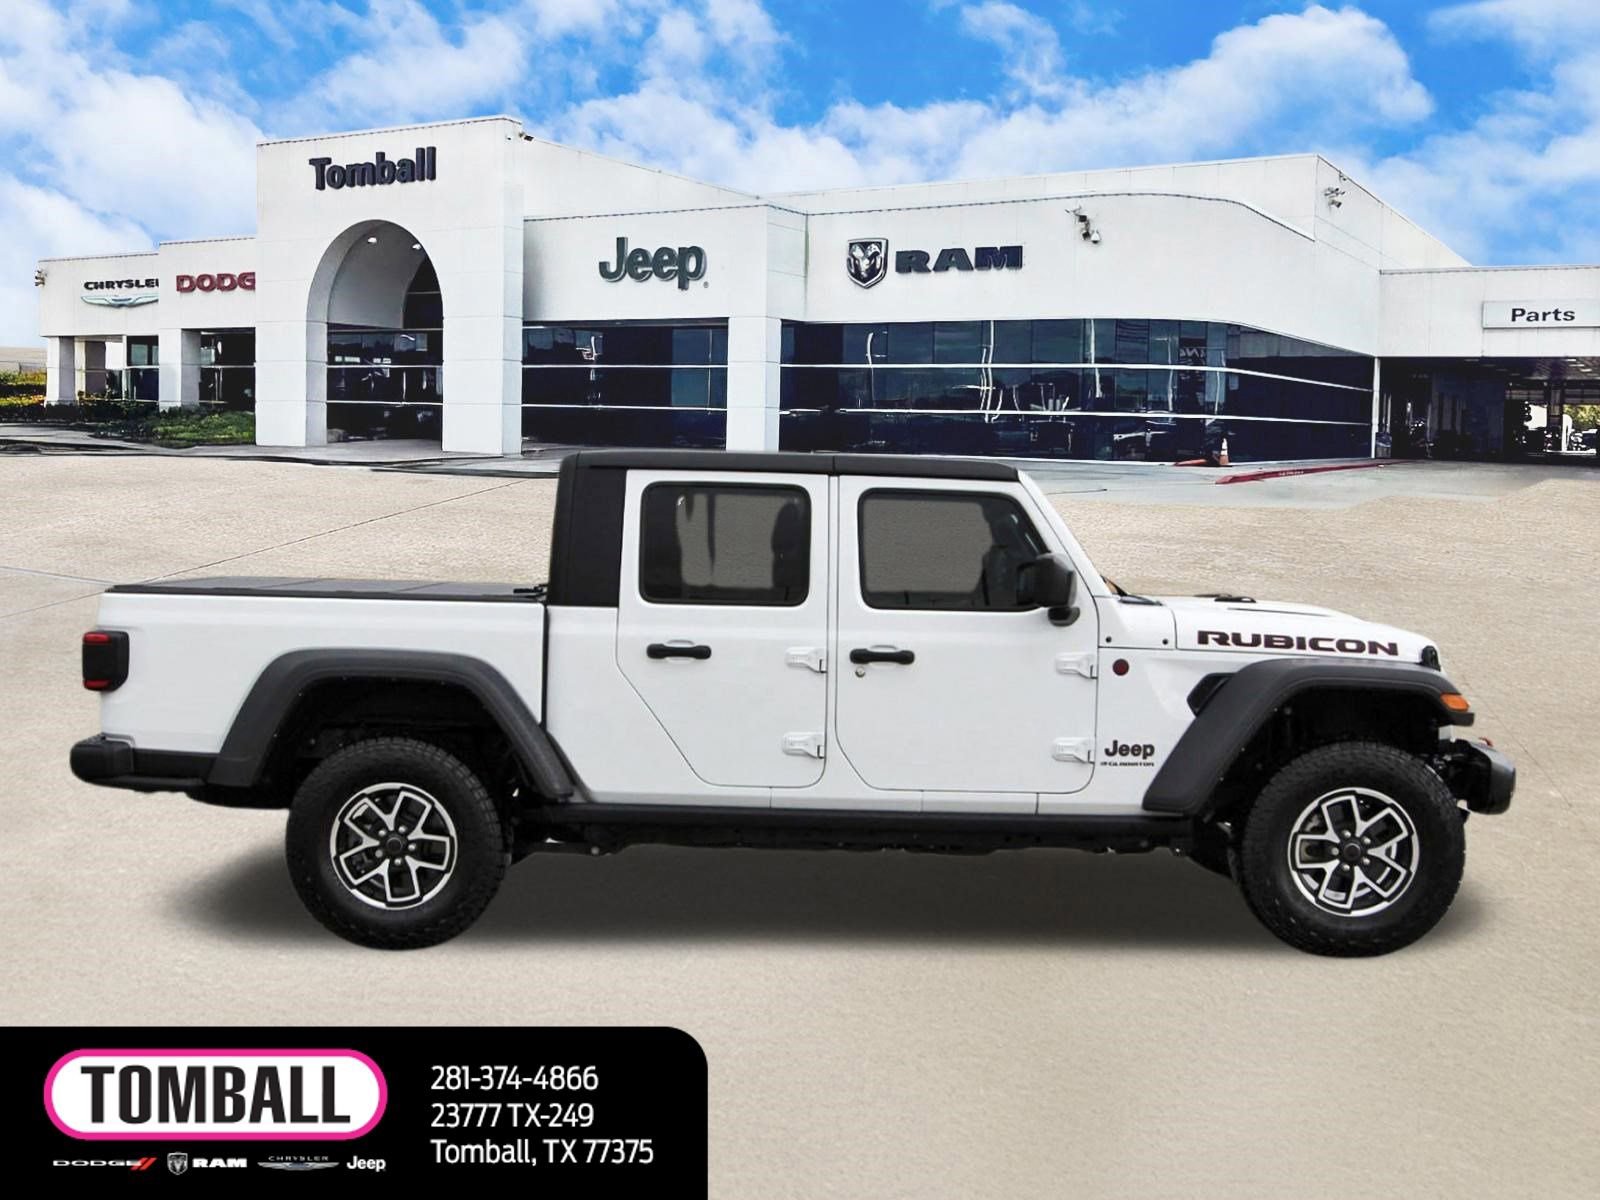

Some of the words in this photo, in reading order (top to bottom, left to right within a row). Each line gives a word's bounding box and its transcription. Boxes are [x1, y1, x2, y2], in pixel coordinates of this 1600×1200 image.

[308, 145, 437, 190] Tomball
[598, 236, 708, 291] Jeep
[895, 245, 1024, 275] RAM
[83, 278, 159, 291] CHRYSLE
[175, 271, 256, 294] DODG
[1511, 307, 1576, 323] Parts
[1197, 630, 1399, 656] RUBICON
[1104, 739, 1155, 760] Jeep
